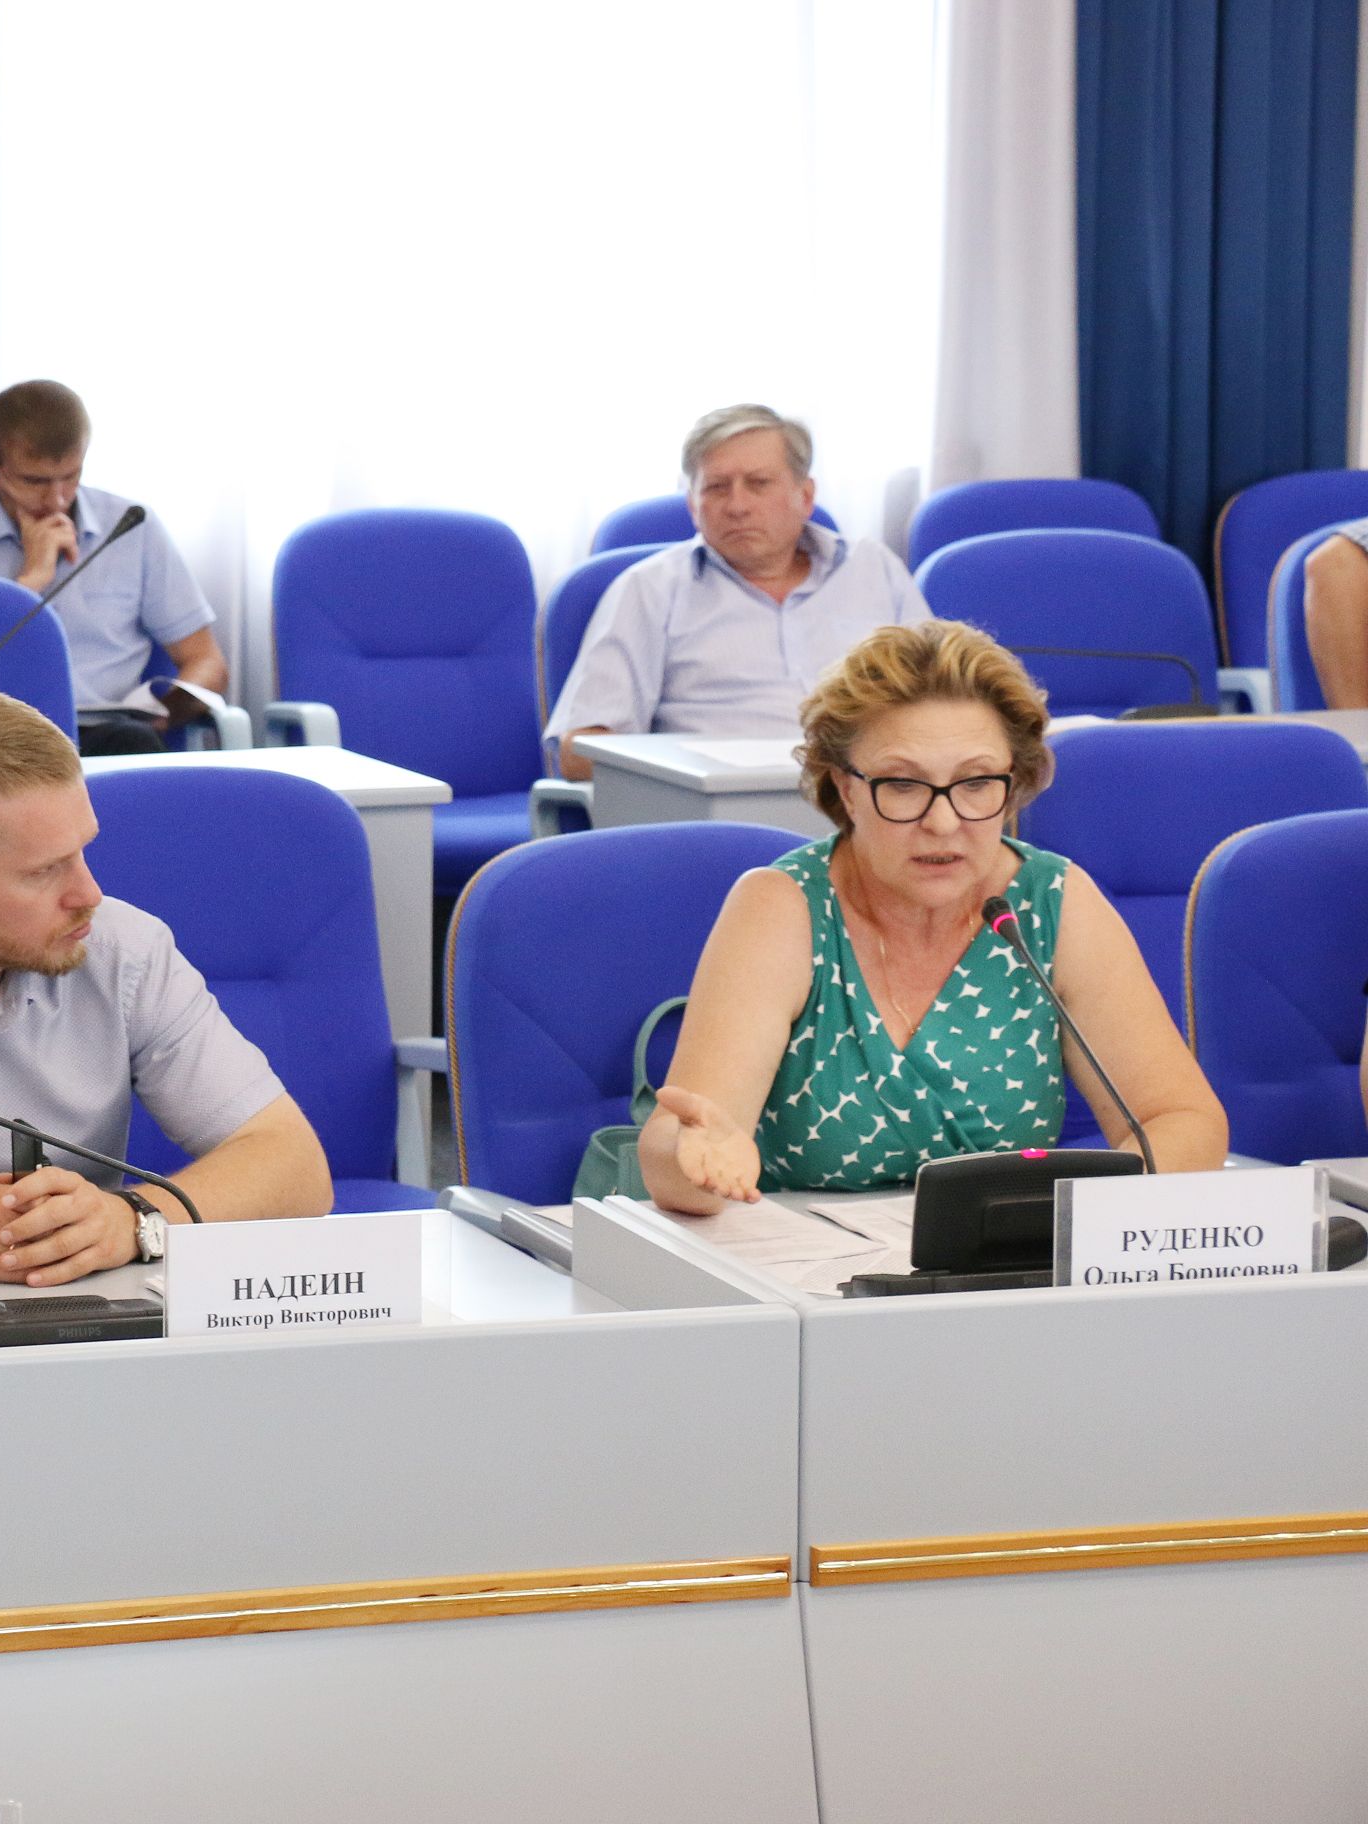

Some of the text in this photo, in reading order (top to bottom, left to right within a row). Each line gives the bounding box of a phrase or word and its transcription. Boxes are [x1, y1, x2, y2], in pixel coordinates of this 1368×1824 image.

[1122, 1225, 1264, 1255] РУДЕНКО
[232, 1271, 365, 1302] НАДЕИН
[1083, 1265, 1159, 1287] Ольга
[206, 1307, 392, 1330] Виктор Викторович
[58, 1326, 103, 1339] PHILIPS
